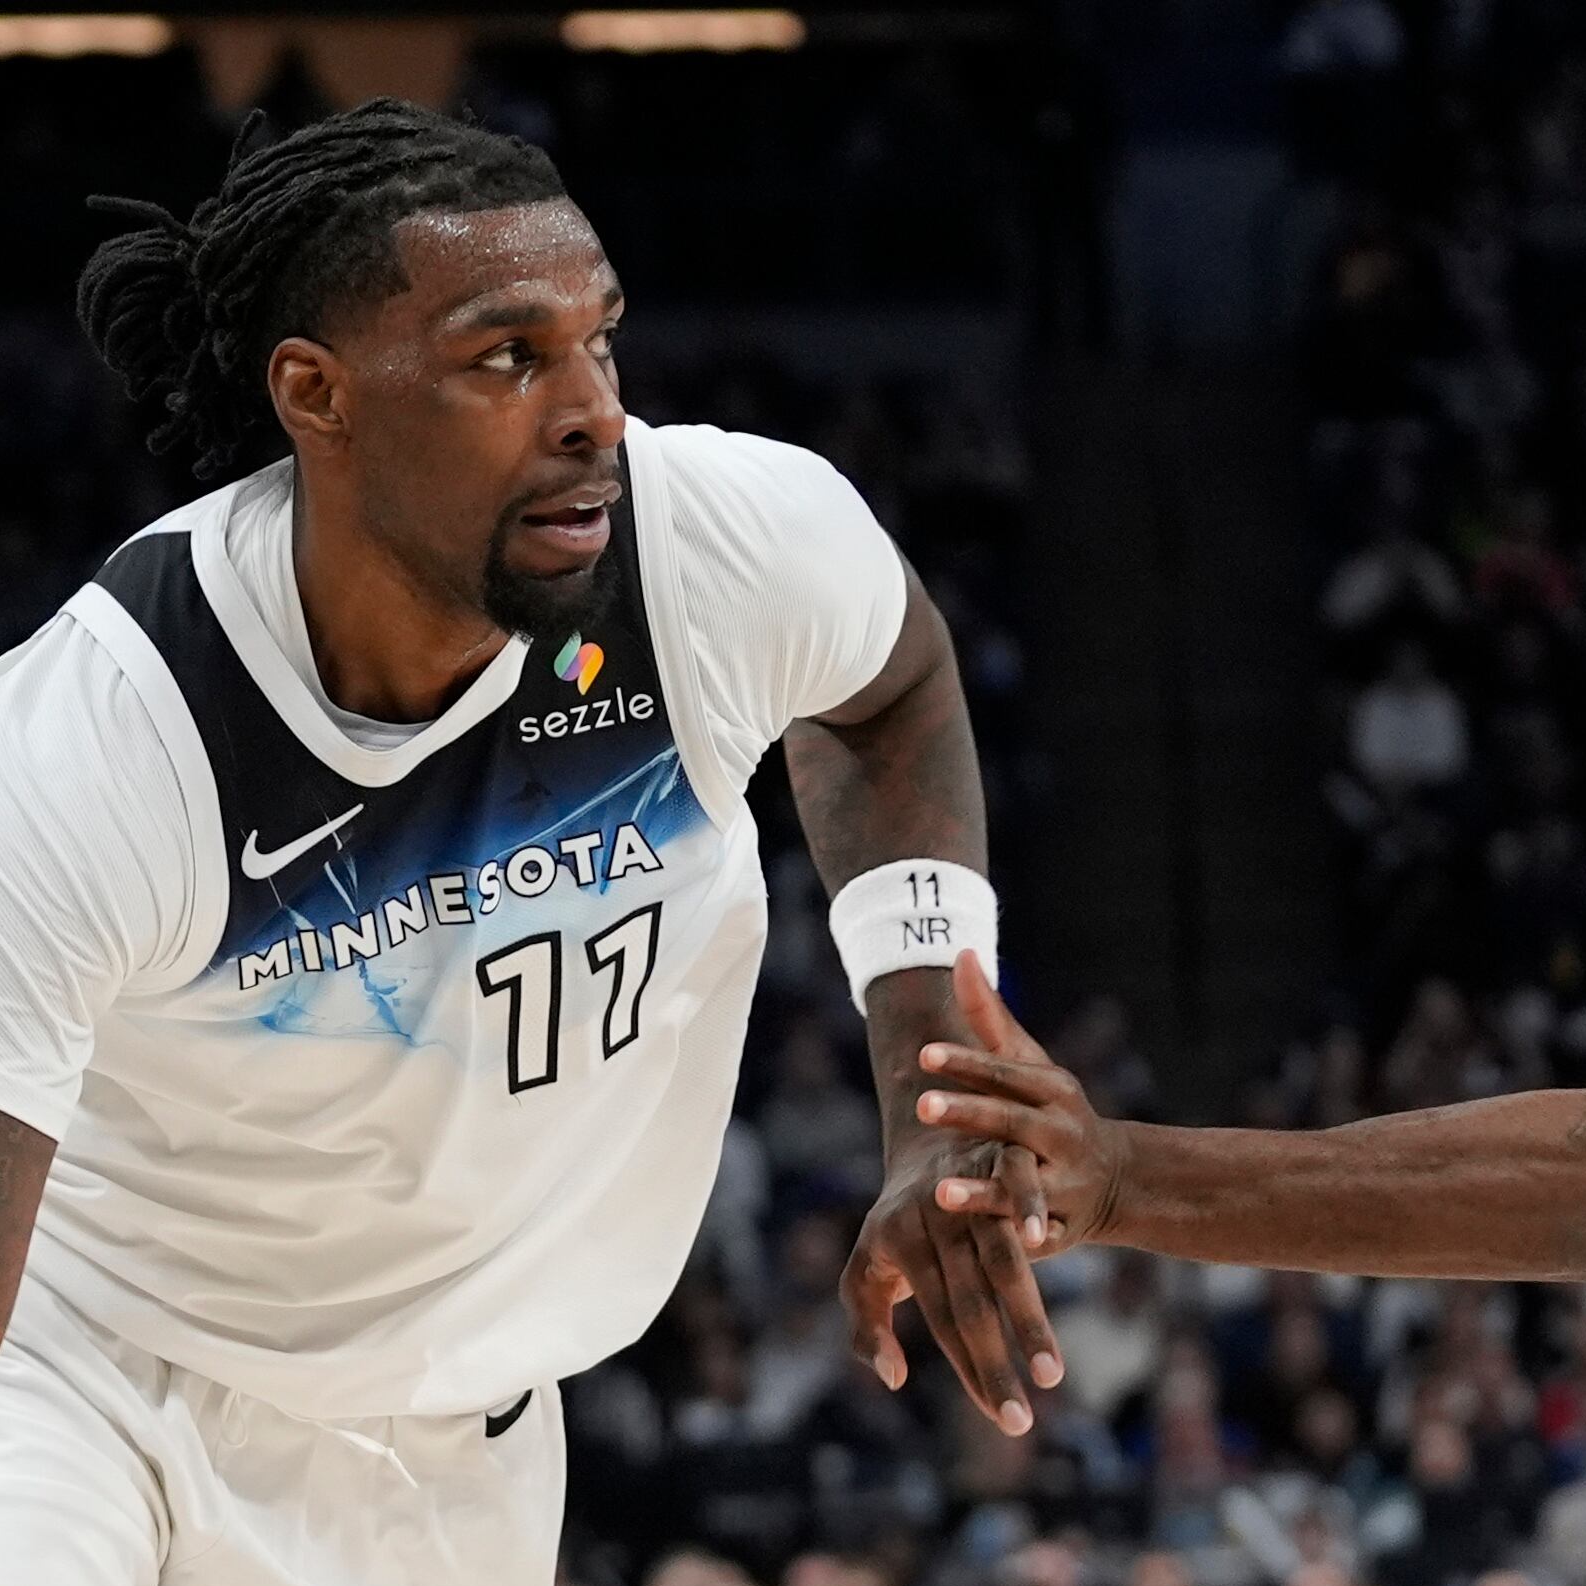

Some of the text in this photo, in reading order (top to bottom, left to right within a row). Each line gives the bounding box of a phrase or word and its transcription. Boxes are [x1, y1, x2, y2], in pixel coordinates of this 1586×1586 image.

[518, 686, 655, 743] sezzle
[237, 821, 664, 991] MINNESOTA
[903, 871, 940, 908] 11
[901, 916, 951, 951] NR
